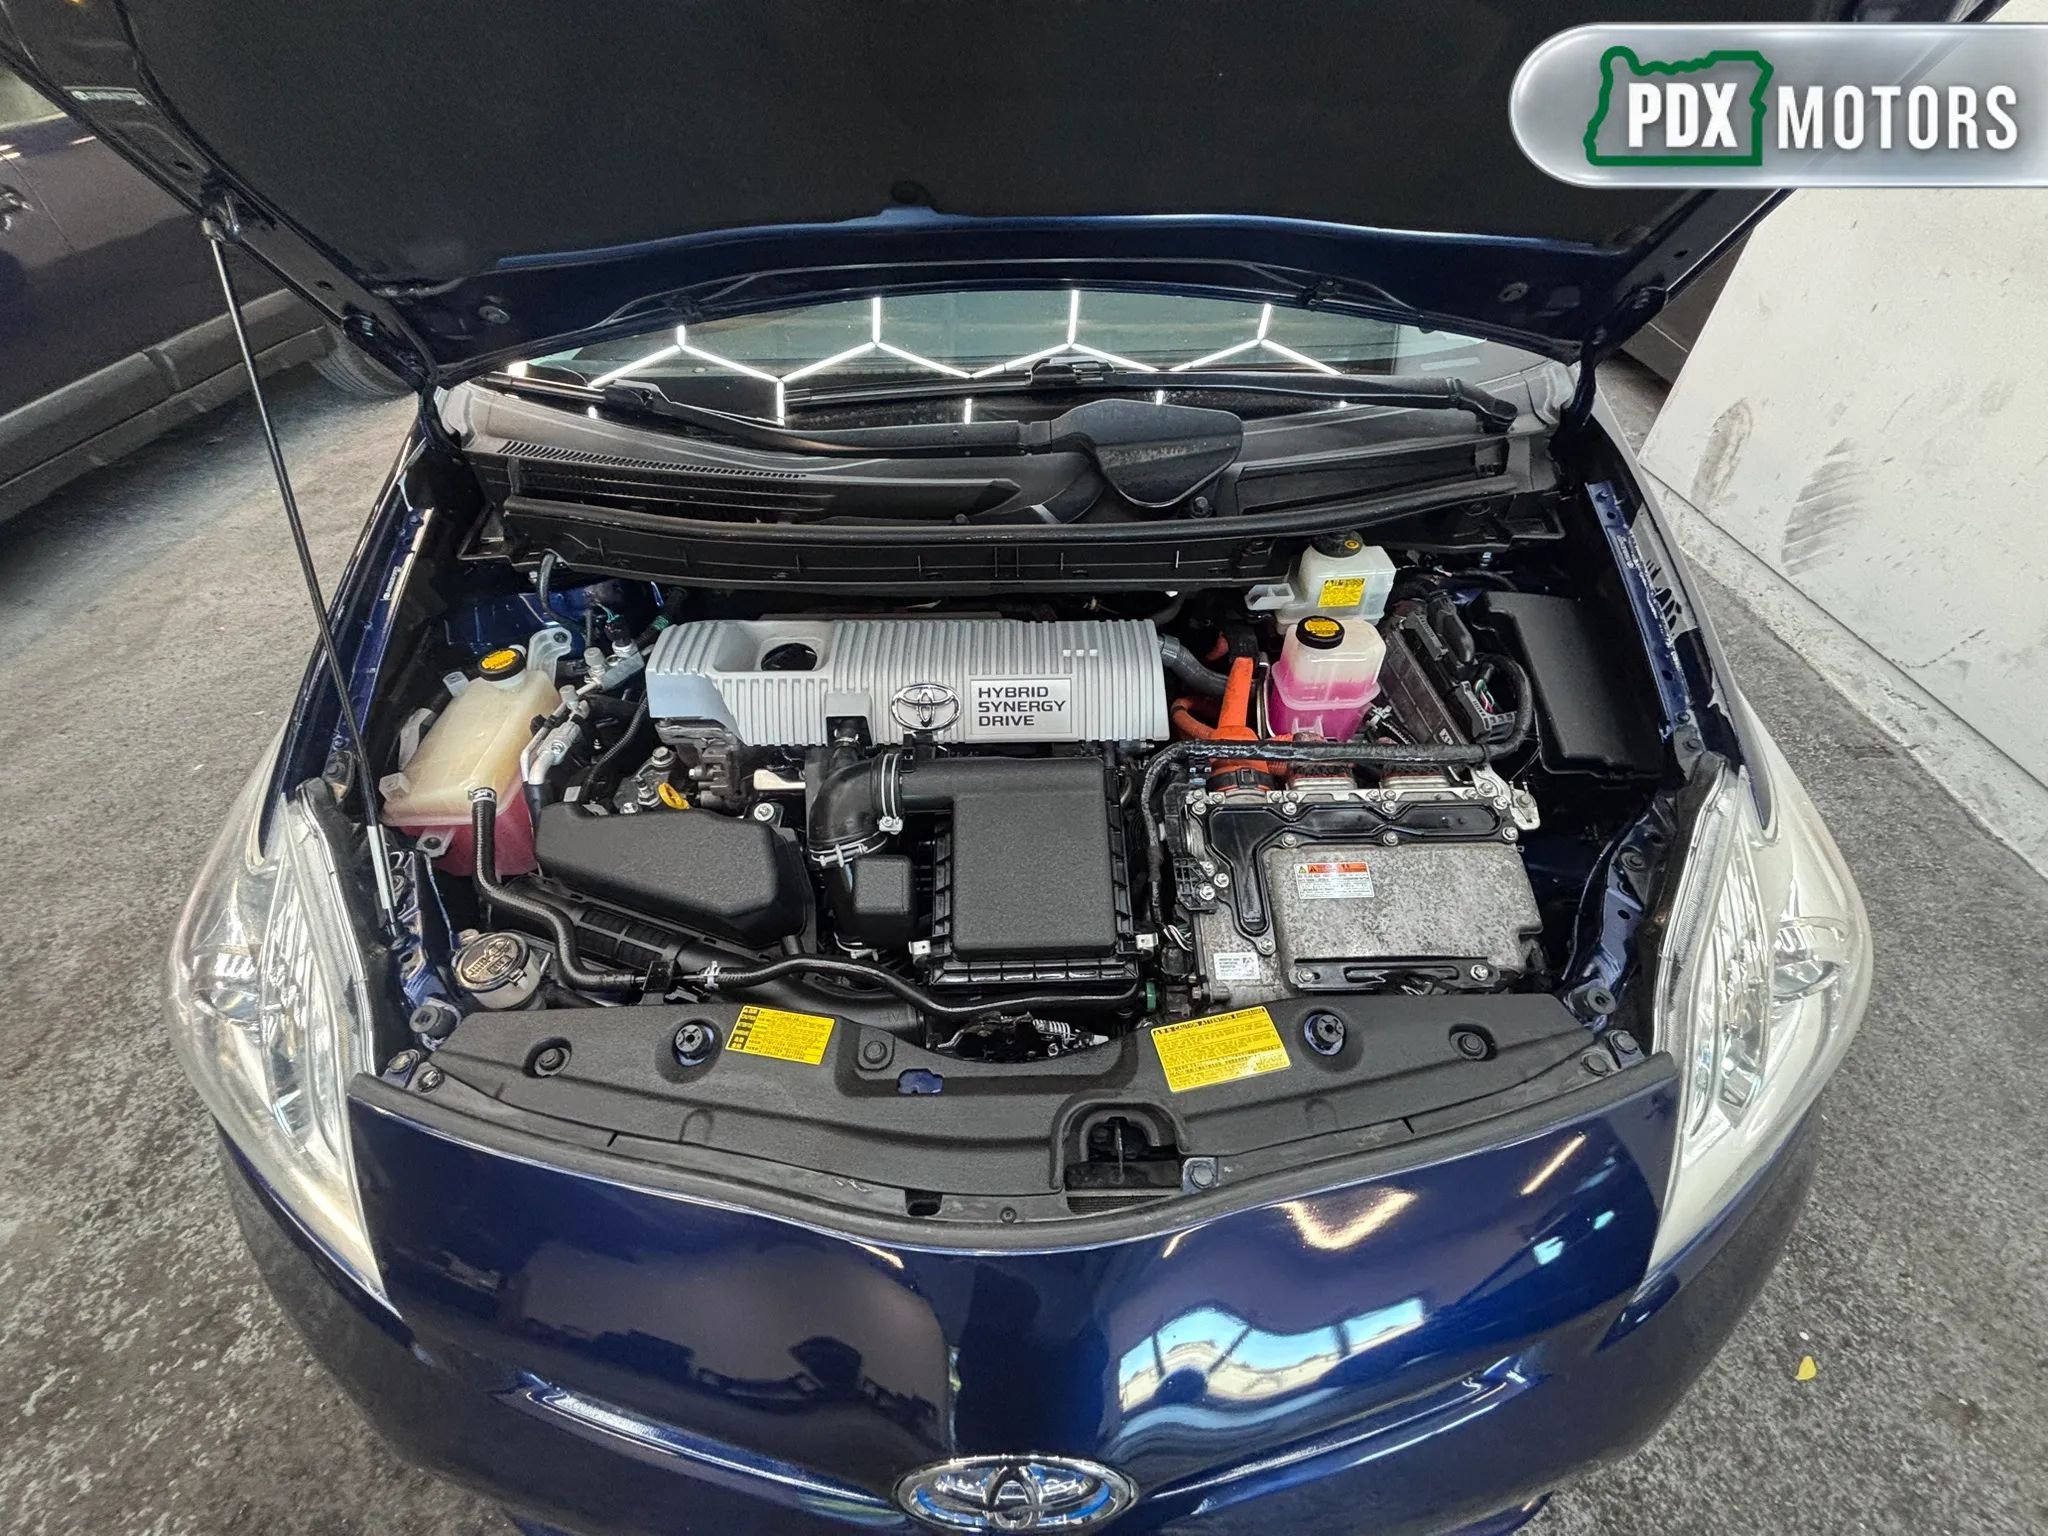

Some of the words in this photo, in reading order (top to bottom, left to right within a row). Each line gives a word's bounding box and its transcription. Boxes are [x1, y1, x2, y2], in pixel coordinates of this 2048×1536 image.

[978, 686, 1049, 698] HYBRID
[978, 700, 1066, 713] SYNERGY
[978, 715, 1035, 727] DRIVE
